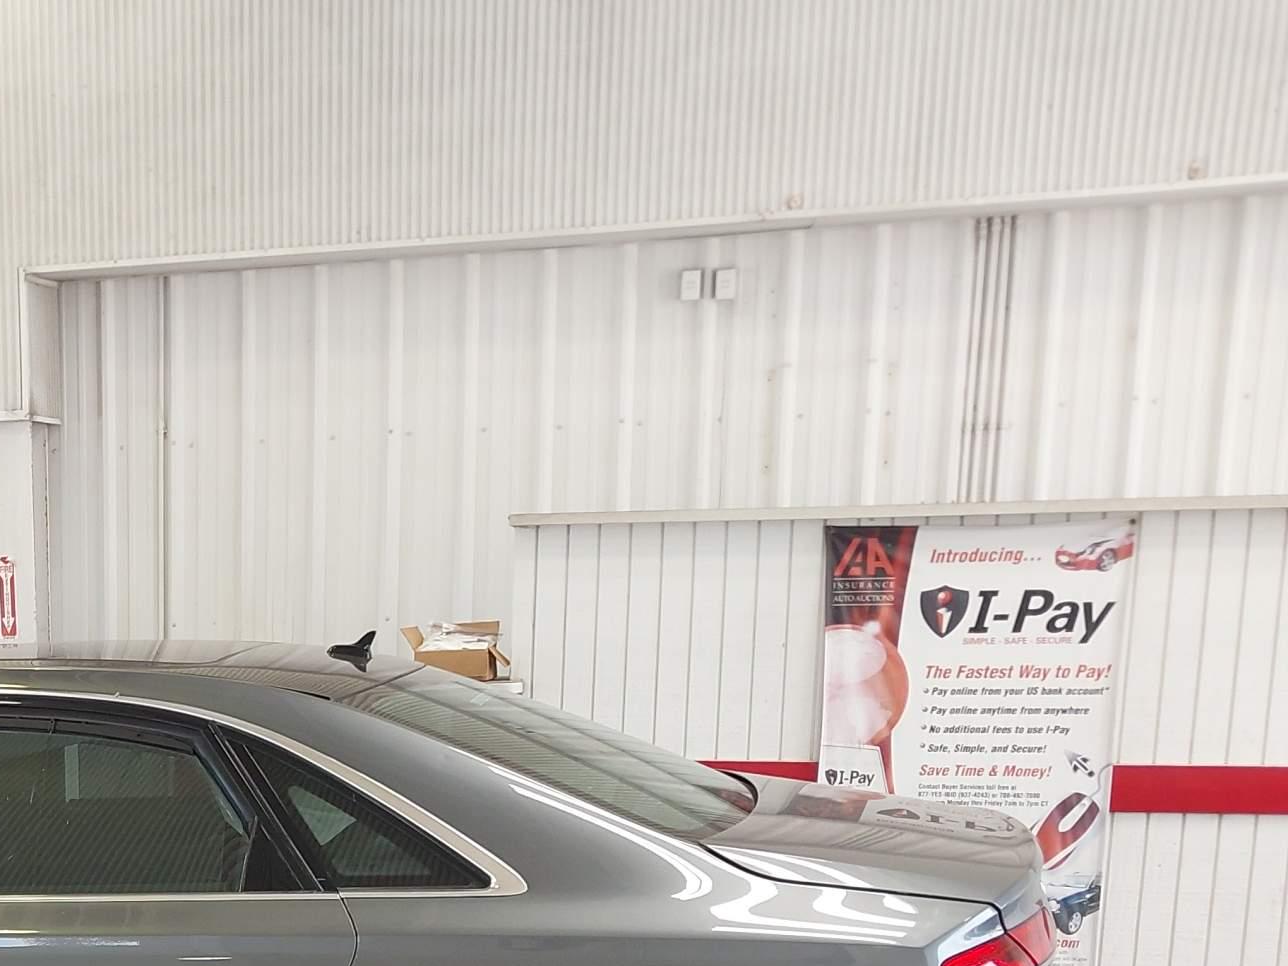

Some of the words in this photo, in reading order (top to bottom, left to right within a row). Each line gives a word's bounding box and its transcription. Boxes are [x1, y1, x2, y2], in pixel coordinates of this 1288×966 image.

[930, 547, 1041, 565] Introducing...
[968, 589, 1117, 644] I-Pay
[962, 637, 996, 645] SIMPLE
[1004, 637, 1027, 645] SAFE
[1036, 636, 1073, 645] SECURE
[925, 665, 952, 679] The
[956, 665, 1014, 679] Fastest
[1019, 664, 1051, 681] Way
[1055, 665, 1071, 679] to
[1075, 664, 1112, 681] Pay!
[931, 686, 948, 697] Pay
[950, 687, 978, 696] online
[981, 687, 1002, 696] from
[1003, 688, 1024, 697] your
[1026, 686, 1039, 696] US
[1041, 687, 1063, 696] bank
[930, 706, 947, 717] Pay
[949, 706, 978, 715] online
[980, 706, 1018, 717] anytime
[1019, 706, 1042, 715] from
[1043, 706, 1090, 717] anywhere
[928, 725, 941, 734] No
[943, 725, 990, 734] additional
[992, 725, 1012, 734] fees
[1015, 726, 1024, 734] to
[1046, 725, 1071, 736] I-Pay
[927, 744, 951, 753] Safe,
[954, 744, 988, 754] Simple,
[991, 744, 1009, 753] and
[1010, 744, 1048, 754] Secure!
[839, 770, 875, 786] I-Pay
[919, 764, 950, 777] Save
[954, 764, 985, 777] Time
[988, 765, 998, 777] &
[1002, 765, 1052, 780] Money!
